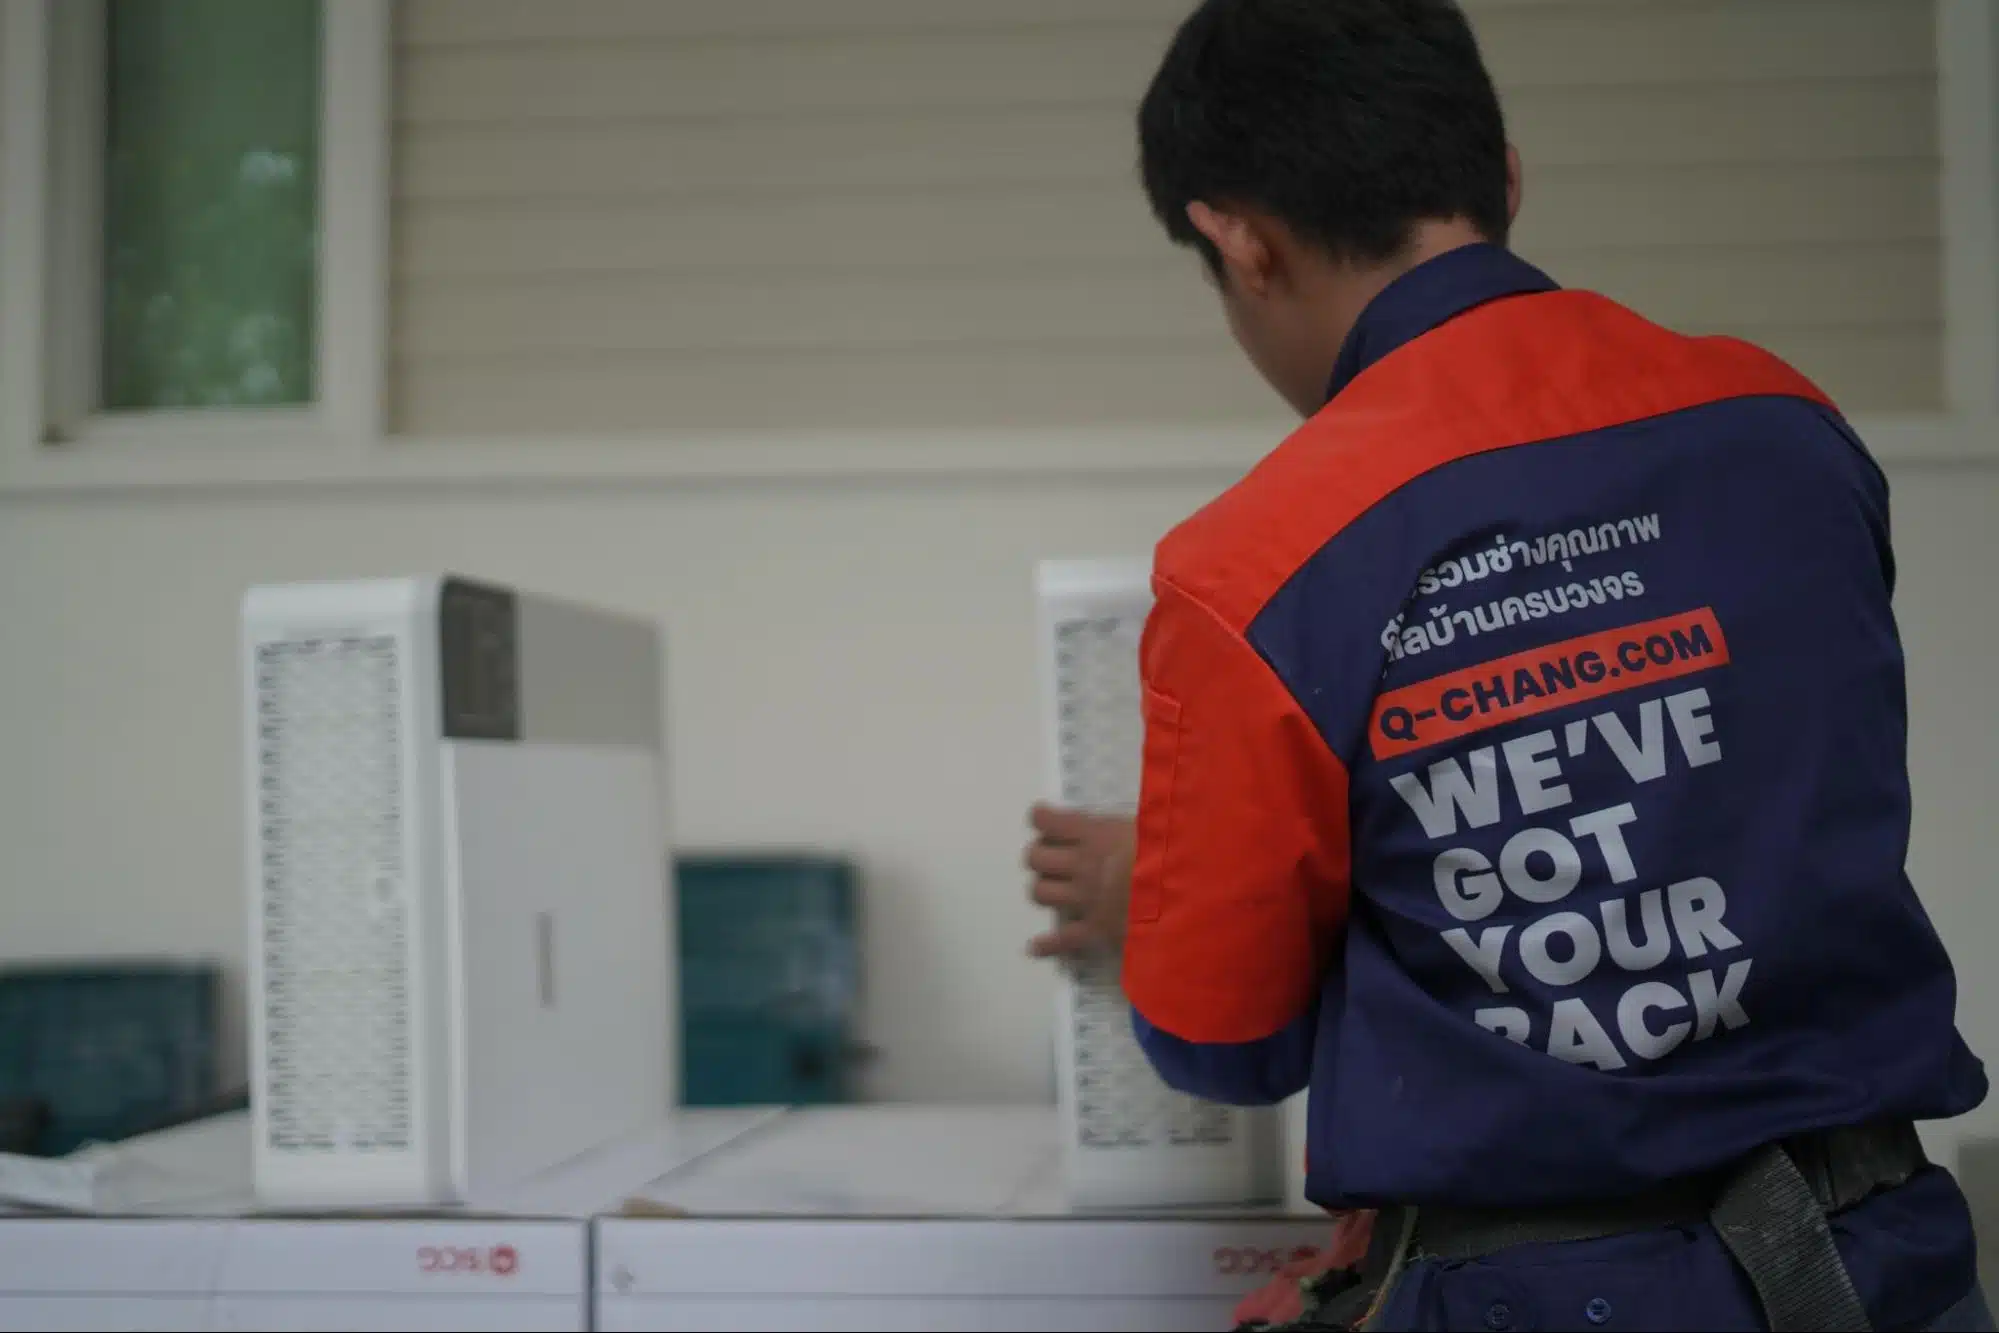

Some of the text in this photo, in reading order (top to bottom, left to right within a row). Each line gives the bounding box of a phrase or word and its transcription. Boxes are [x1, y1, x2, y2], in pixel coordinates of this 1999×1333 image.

[1412, 513, 1661, 597] รวมช่างคุณภาพ
[1379, 623, 1714, 742] Q-CHANG.COM
[1388, 687, 1722, 839] WE'VE
[1433, 802, 1638, 922] GOT
[1440, 876, 1743, 994] YOUR
